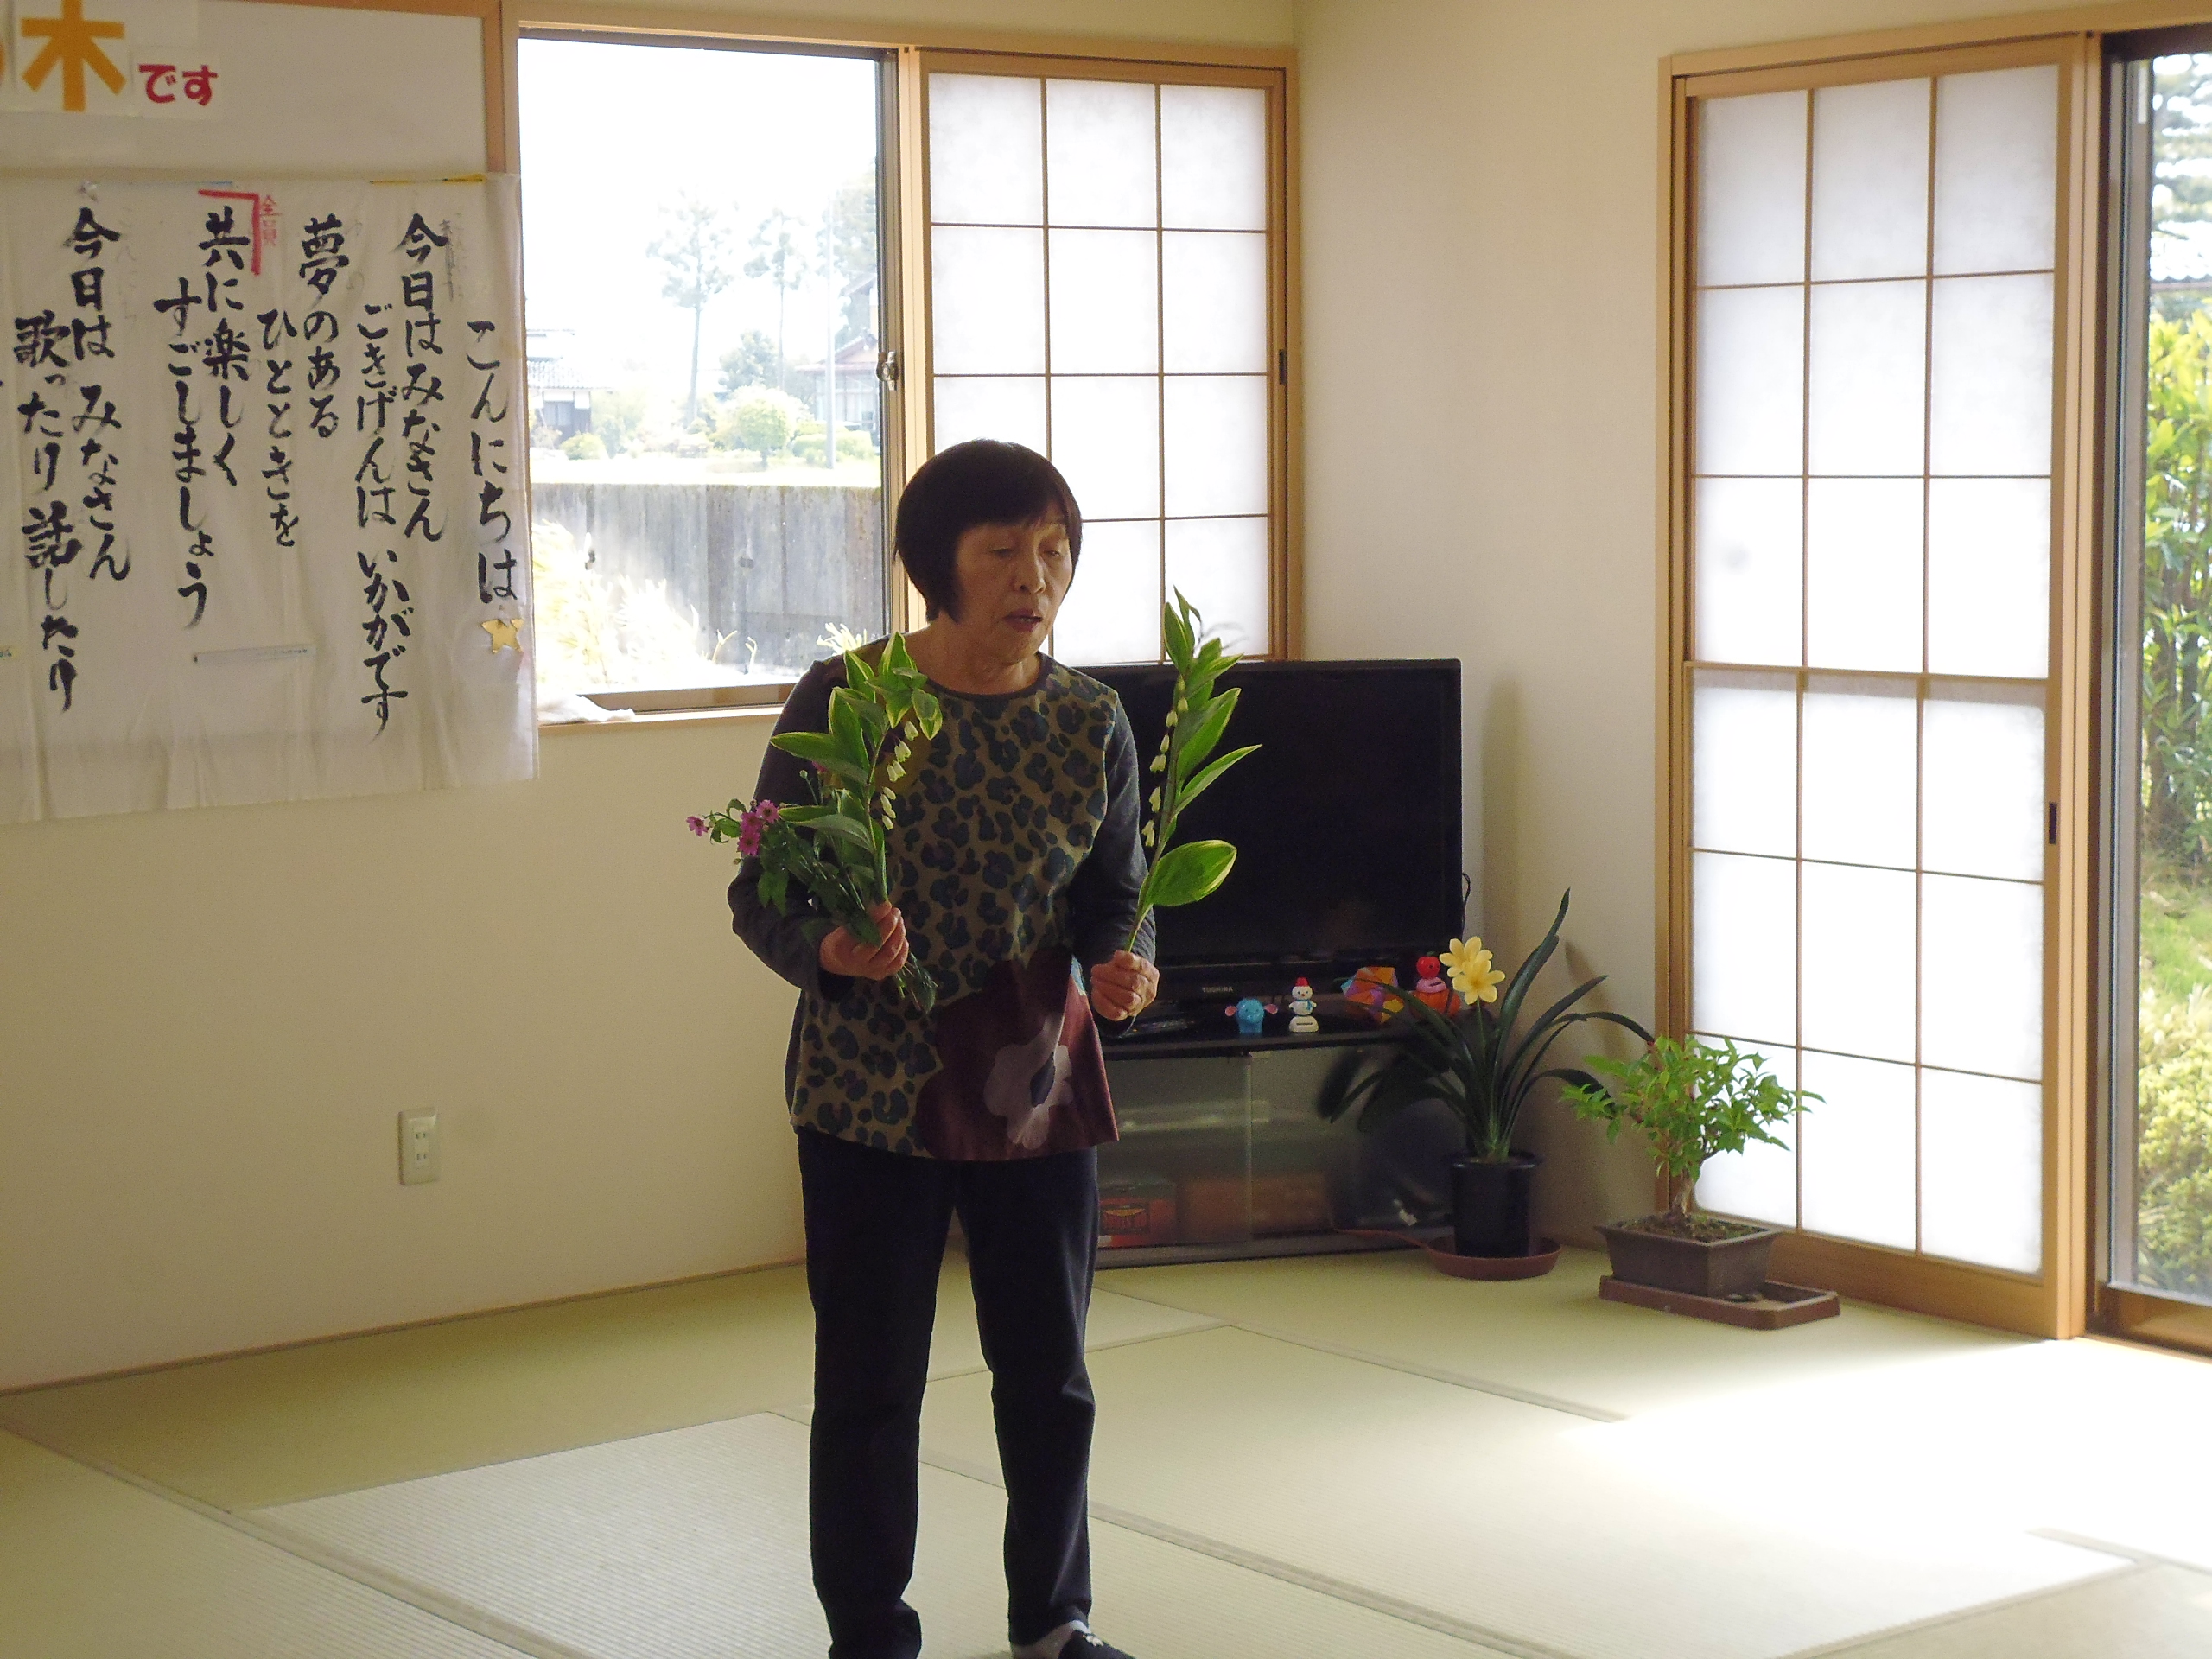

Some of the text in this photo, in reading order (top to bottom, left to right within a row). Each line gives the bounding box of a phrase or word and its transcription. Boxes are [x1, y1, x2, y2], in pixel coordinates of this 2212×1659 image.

[138, 64, 219, 106] です
[154, 277, 214, 628] すごしましょう
[199, 206, 251, 486] 共に楽しく
[257, 308, 300, 547] ひとときを
[299, 213, 349, 437] 夢のある
[394, 213, 448, 542] 今日はみなさん
[467, 321, 518, 603] こんにちは
